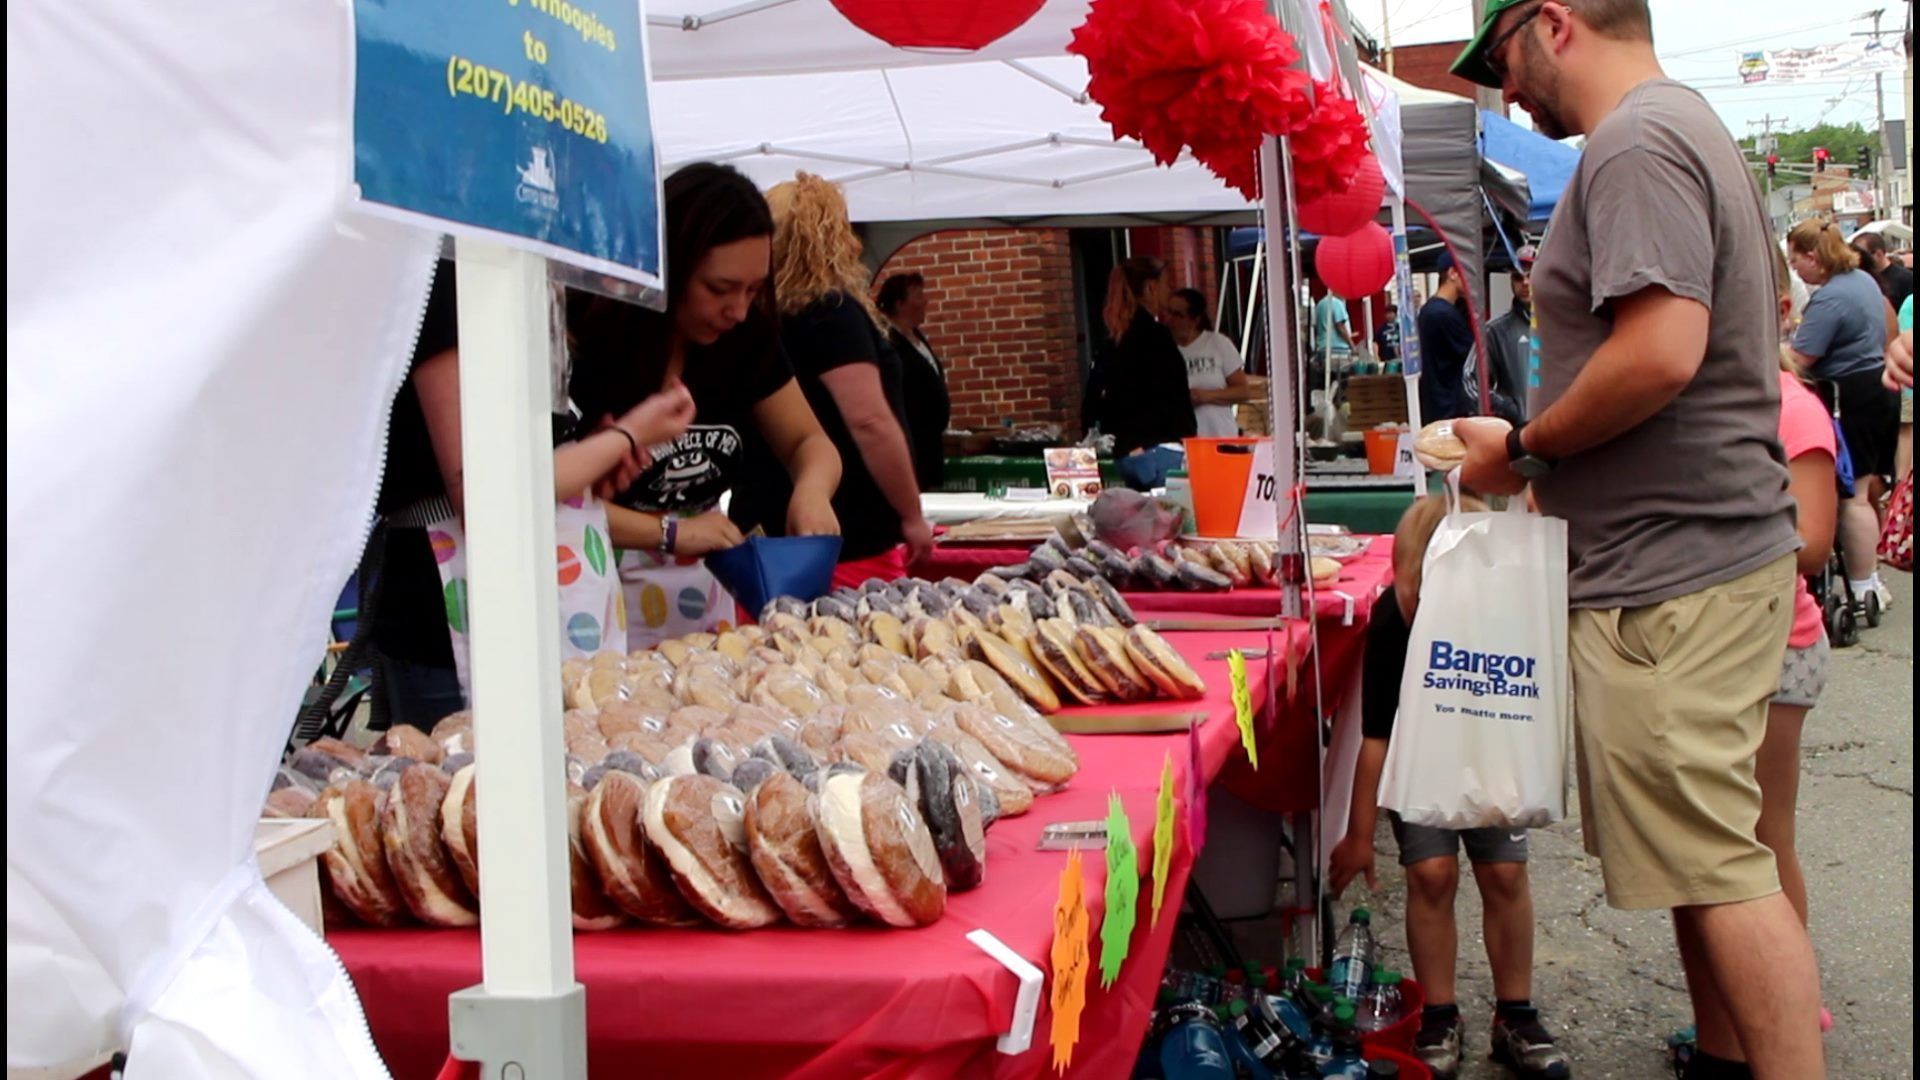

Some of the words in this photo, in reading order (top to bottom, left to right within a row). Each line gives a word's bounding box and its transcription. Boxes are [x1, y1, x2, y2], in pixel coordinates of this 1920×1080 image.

[523, 31, 547, 64] to
[447, 56, 607, 143] (207)405-0526
[705, 430, 720, 448] OF
[1256, 473, 1277, 501] TO
[1429, 640, 1536, 681] Bangor
[1493, 679, 1539, 699] Bank
